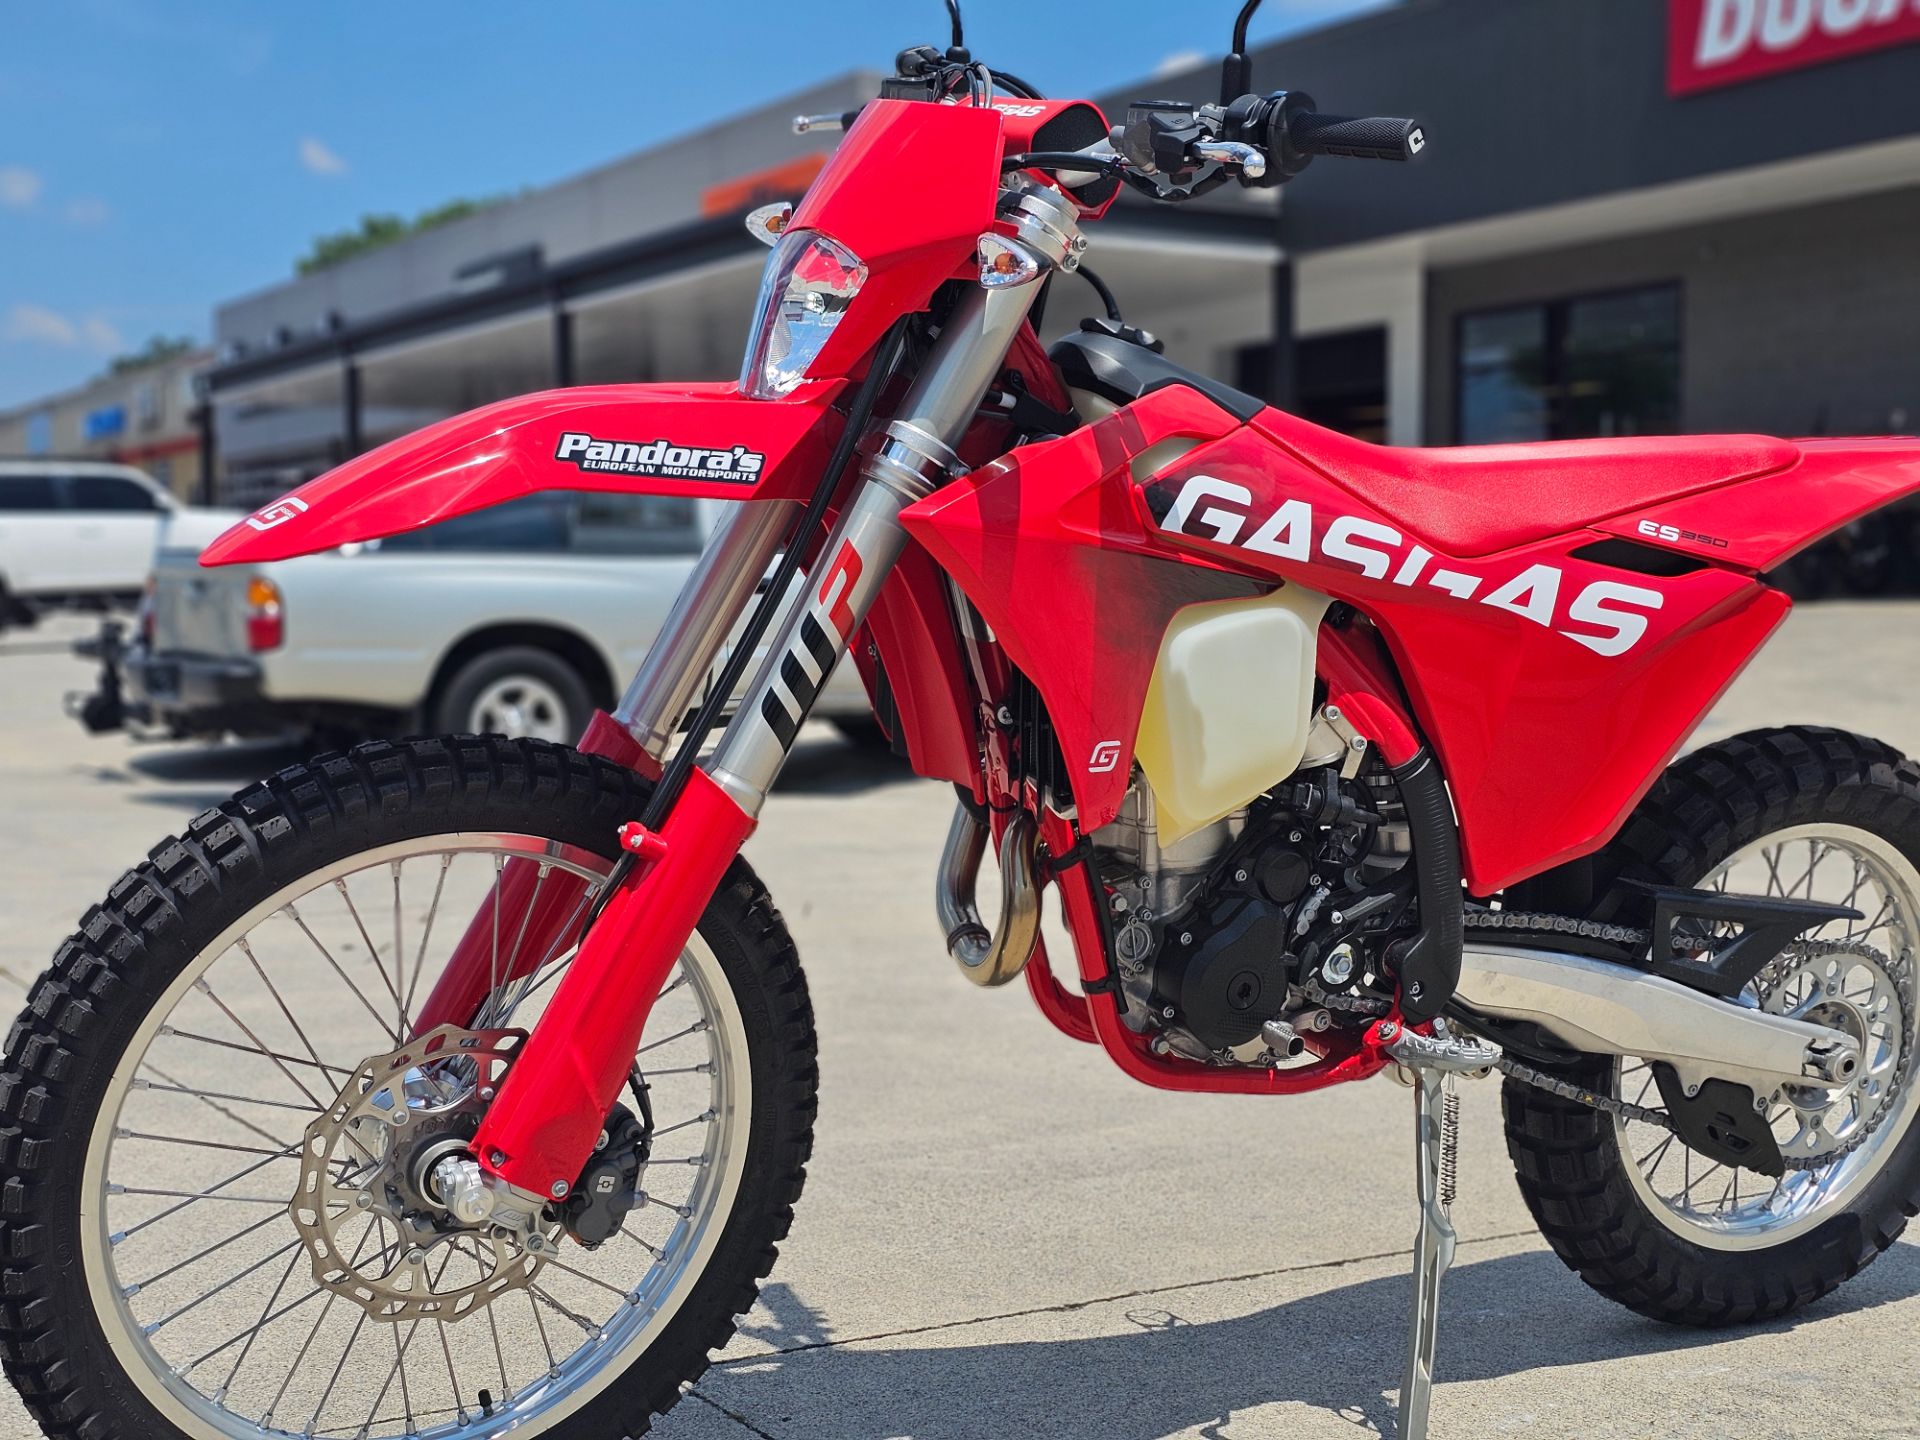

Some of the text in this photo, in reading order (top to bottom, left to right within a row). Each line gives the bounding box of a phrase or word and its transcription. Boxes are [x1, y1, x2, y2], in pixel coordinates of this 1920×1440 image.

[557, 433, 764, 473] Pandora's
[583, 460, 757, 482] EUROPEAN MOTORSPORTS
